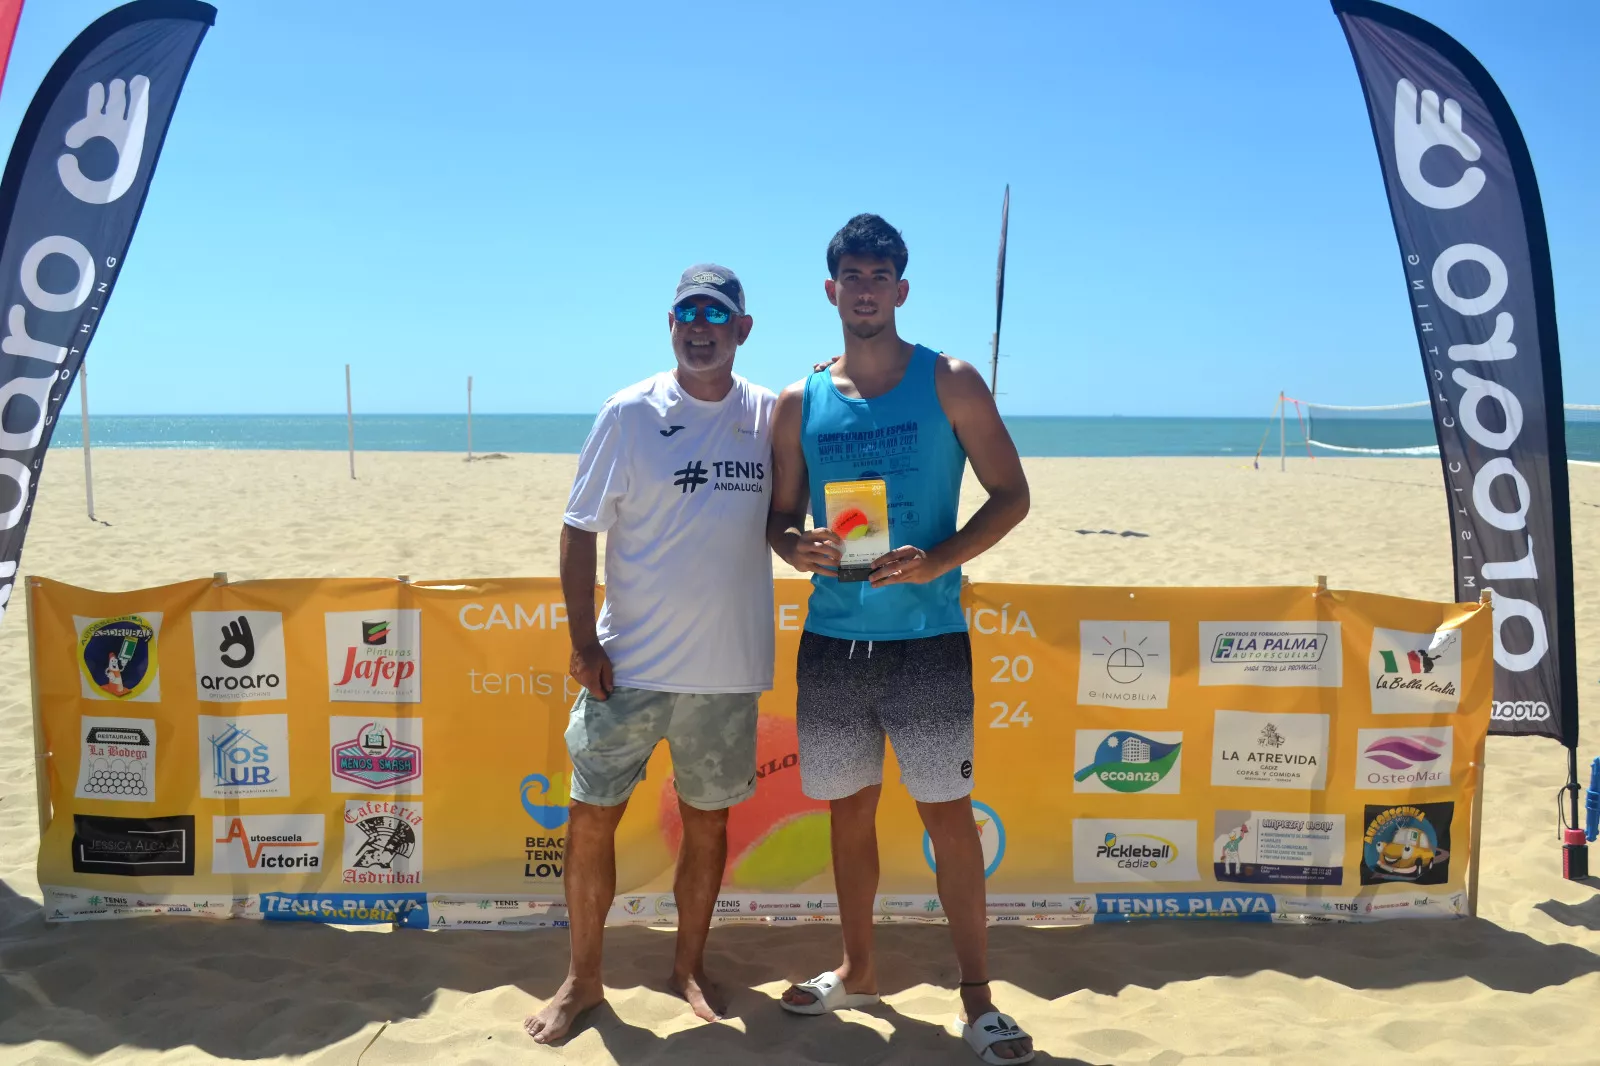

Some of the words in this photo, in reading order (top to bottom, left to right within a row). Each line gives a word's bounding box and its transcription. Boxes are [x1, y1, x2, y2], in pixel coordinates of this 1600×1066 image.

[712, 461, 765, 480] TENIS
[713, 482, 763, 493] ANDALUCÍA
[458, 603, 569, 631] CAMP
[366, 647, 412, 656] Pinturas
[1236, 638, 1257, 651] LA
[1263, 638, 1318, 651] PALMA
[1232, 651, 1316, 659] AUTOESCUELAS
[333, 646, 415, 688] Jafep
[989, 655, 1034, 683] 20
[200, 673, 280, 690] aroaro
[467, 666, 553, 696] tenis
[1376, 674, 1388, 690] La
[1389, 676, 1422, 690] Bella
[1424, 681, 1456, 696] Italia
[989, 701, 1034, 729] 24
[97, 733, 139, 741] RESTAURANTE
[88, 744, 104, 756] La
[107, 745, 148, 760] Bodega
[228, 745, 269, 765] OS
[1222, 750, 1240, 761] LA
[1247, 752, 1317, 766] ATREVIDA
[340, 757, 373, 770] MENOS
[378, 758, 413, 772] SMASH
[229, 765, 271, 785] UR
[1100, 771, 1160, 782] ecoanza
[1367, 771, 1442, 784] OsteoMar
[88, 839, 132, 851] JESSICA
[525, 836, 565, 848] BEAC
[525, 850, 563, 861] TENN
[1096, 844, 1170, 858] Pickleball
[524, 863, 563, 878] LOV
[1117, 859, 1149, 868] Cádiz
[104, 896, 128, 904] TENIS
[266, 895, 335, 912] TENIS
[1102, 898, 1180, 913] TENIS
[1189, 897, 1270, 913] PLAYA
[1334, 903, 1358, 911] TENIS
